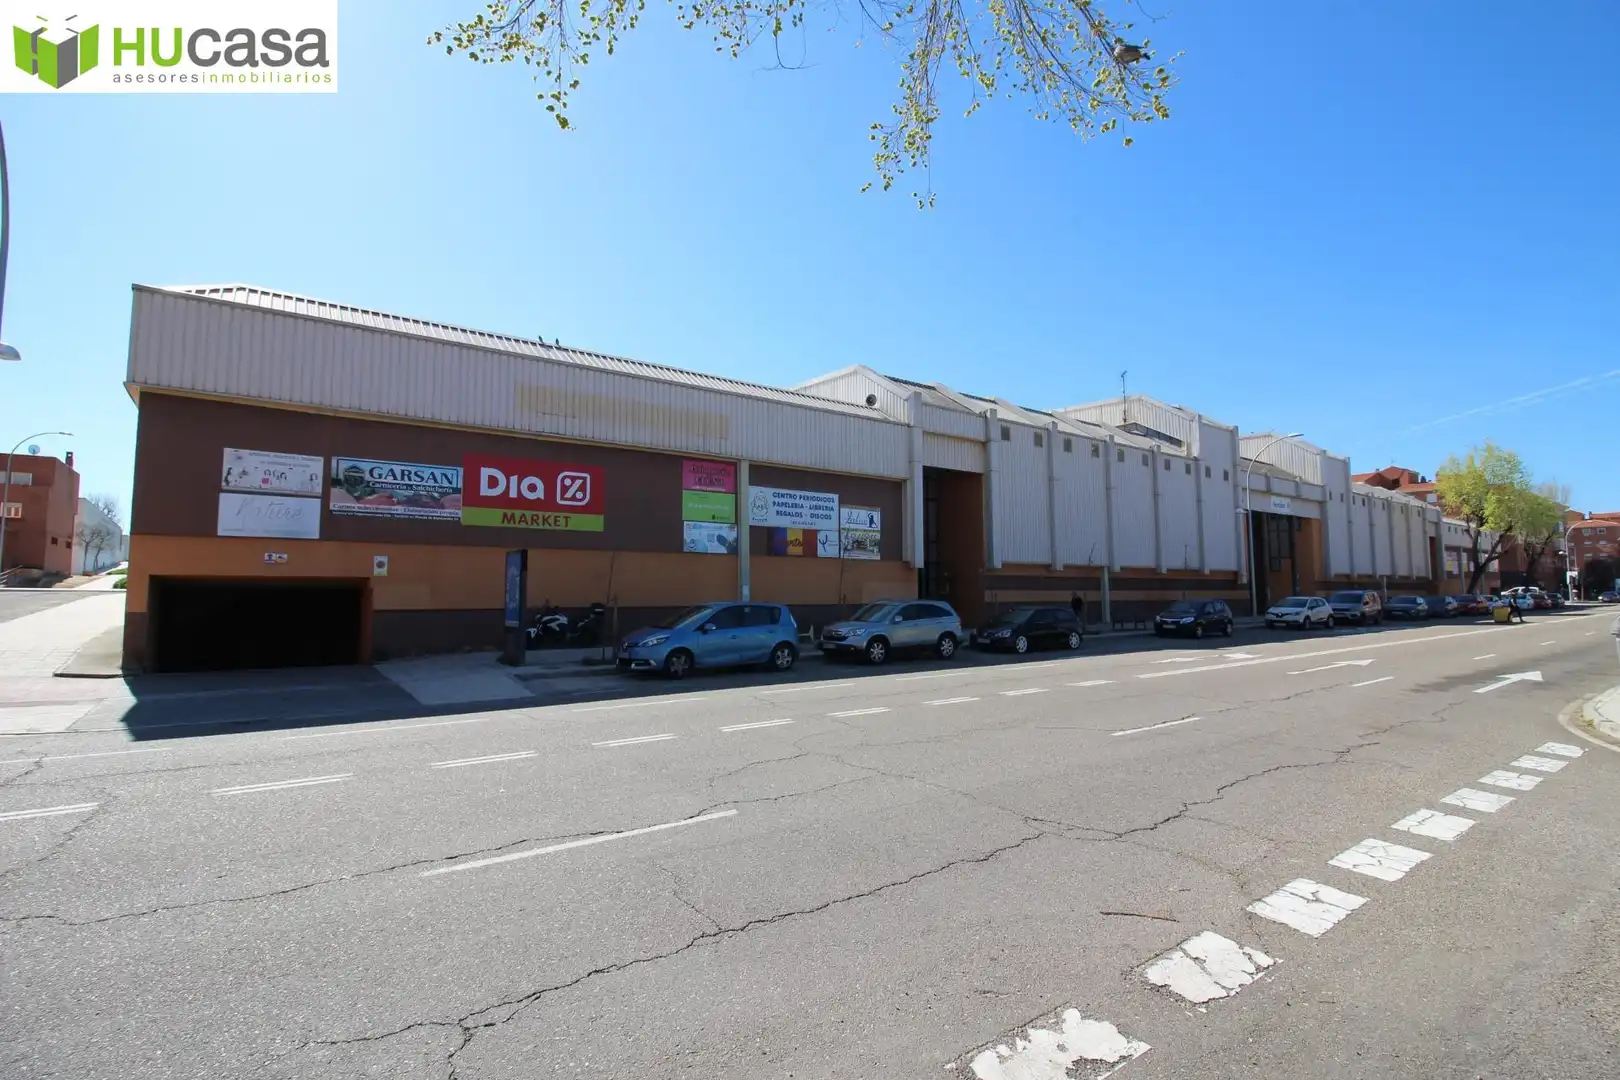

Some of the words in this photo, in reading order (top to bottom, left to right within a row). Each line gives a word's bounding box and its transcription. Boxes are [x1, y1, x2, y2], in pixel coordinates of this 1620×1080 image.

[368, 466, 455, 485] GARSAN
[772, 491, 797, 500] CENTRO
[798, 494, 835, 503] PERIODICOS
[501, 511, 572, 528] MARKET
[775, 510, 803, 518] REGALOS
[809, 512, 832, 520] DISCOS
